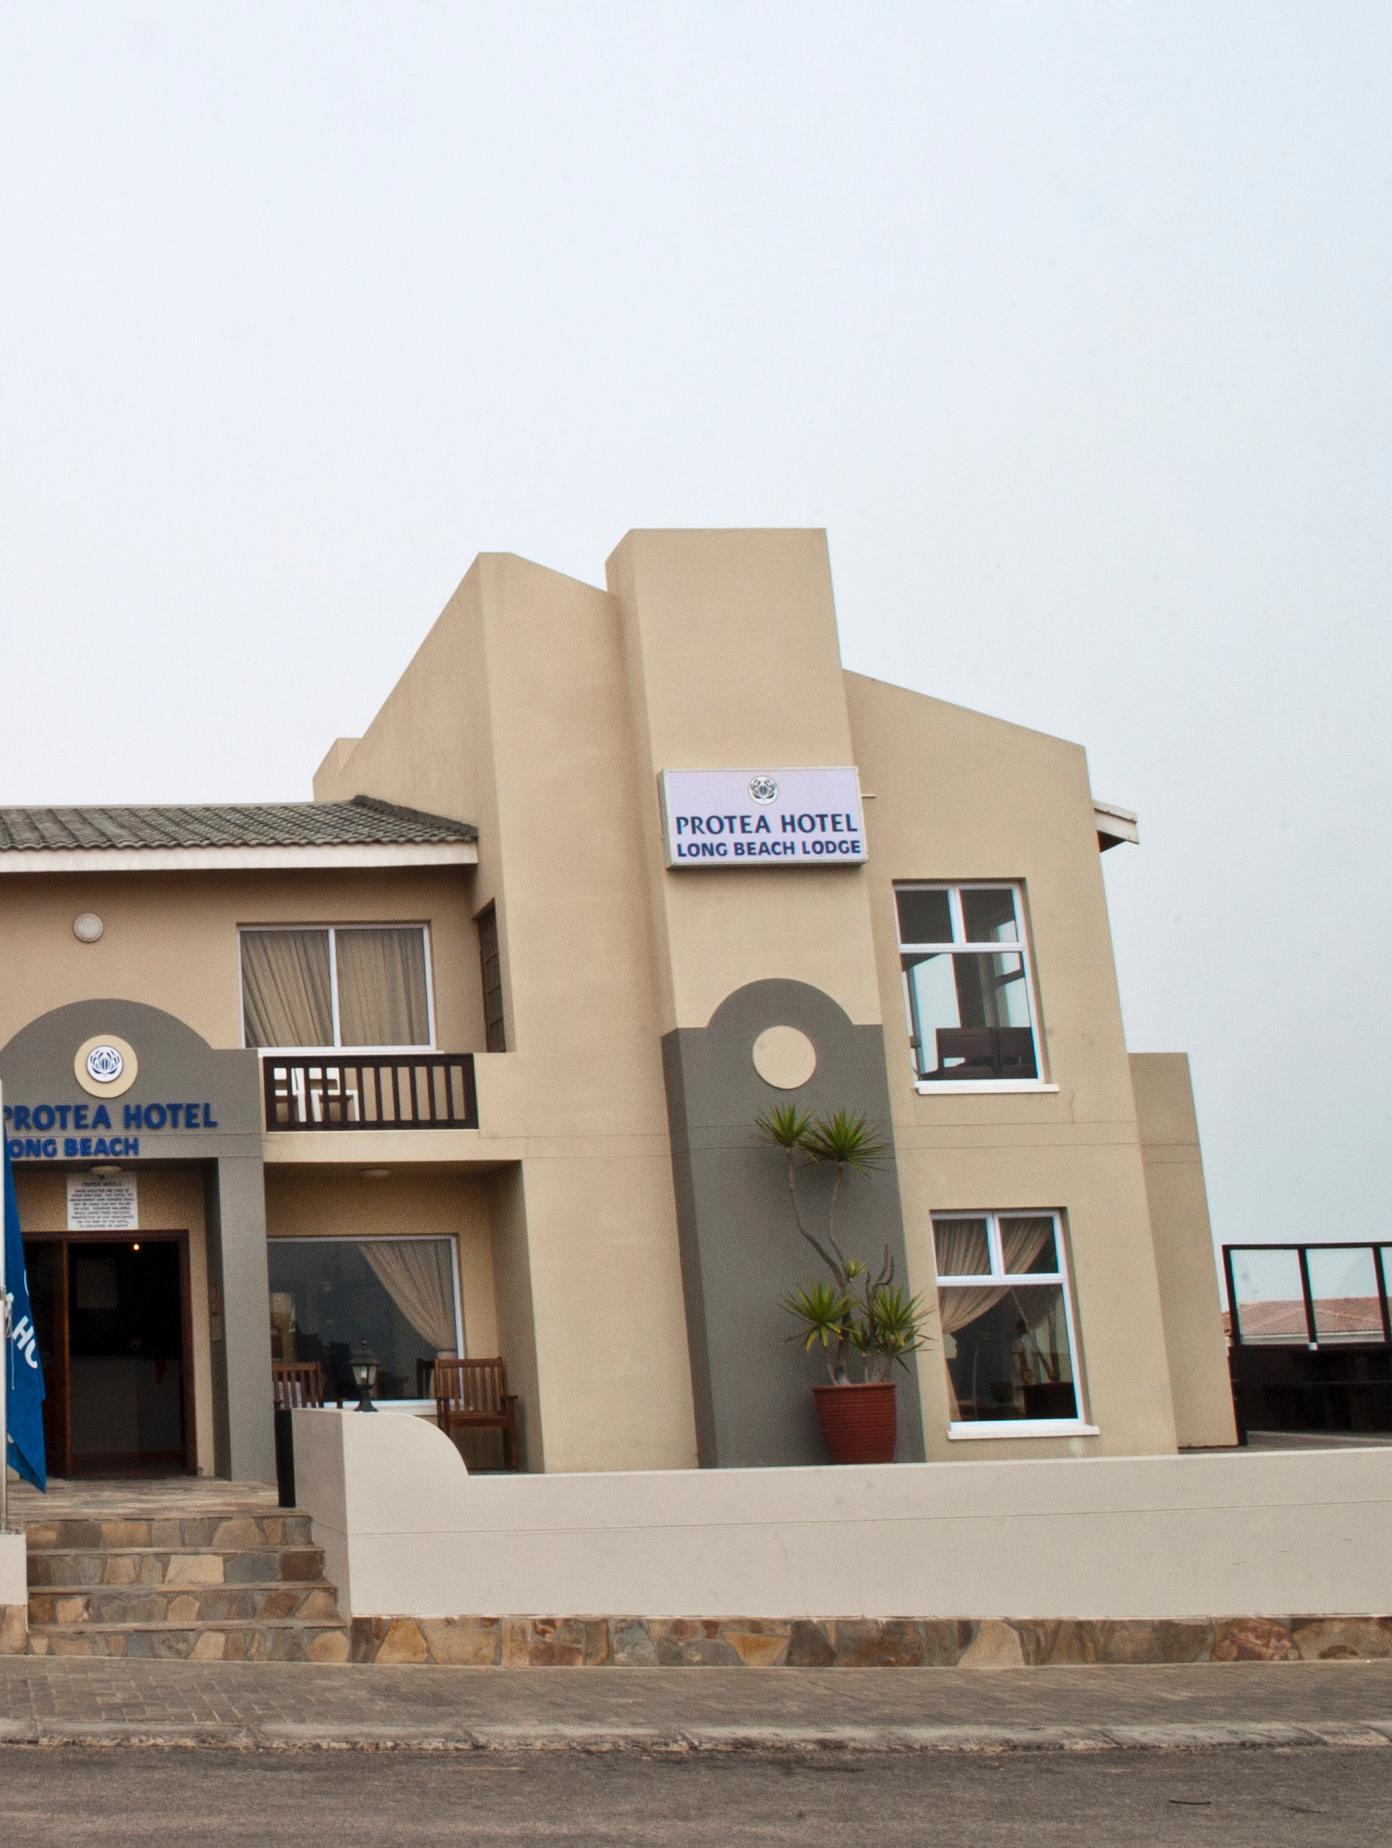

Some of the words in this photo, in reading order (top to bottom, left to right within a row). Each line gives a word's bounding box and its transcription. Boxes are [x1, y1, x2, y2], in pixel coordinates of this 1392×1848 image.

[676, 815, 771, 835] PROTEA
[781, 813, 858, 833] HOTEL
[677, 842, 729, 857] LONG
[733, 841, 795, 856] BEACH
[802, 840, 861, 854] LODGE
[3, 1103, 112, 1130] PROTEA
[123, 1102, 218, 1129] HOTEL
[9, 1138, 58, 1158] ONG
[64, 1137, 139, 1157] BEACH
